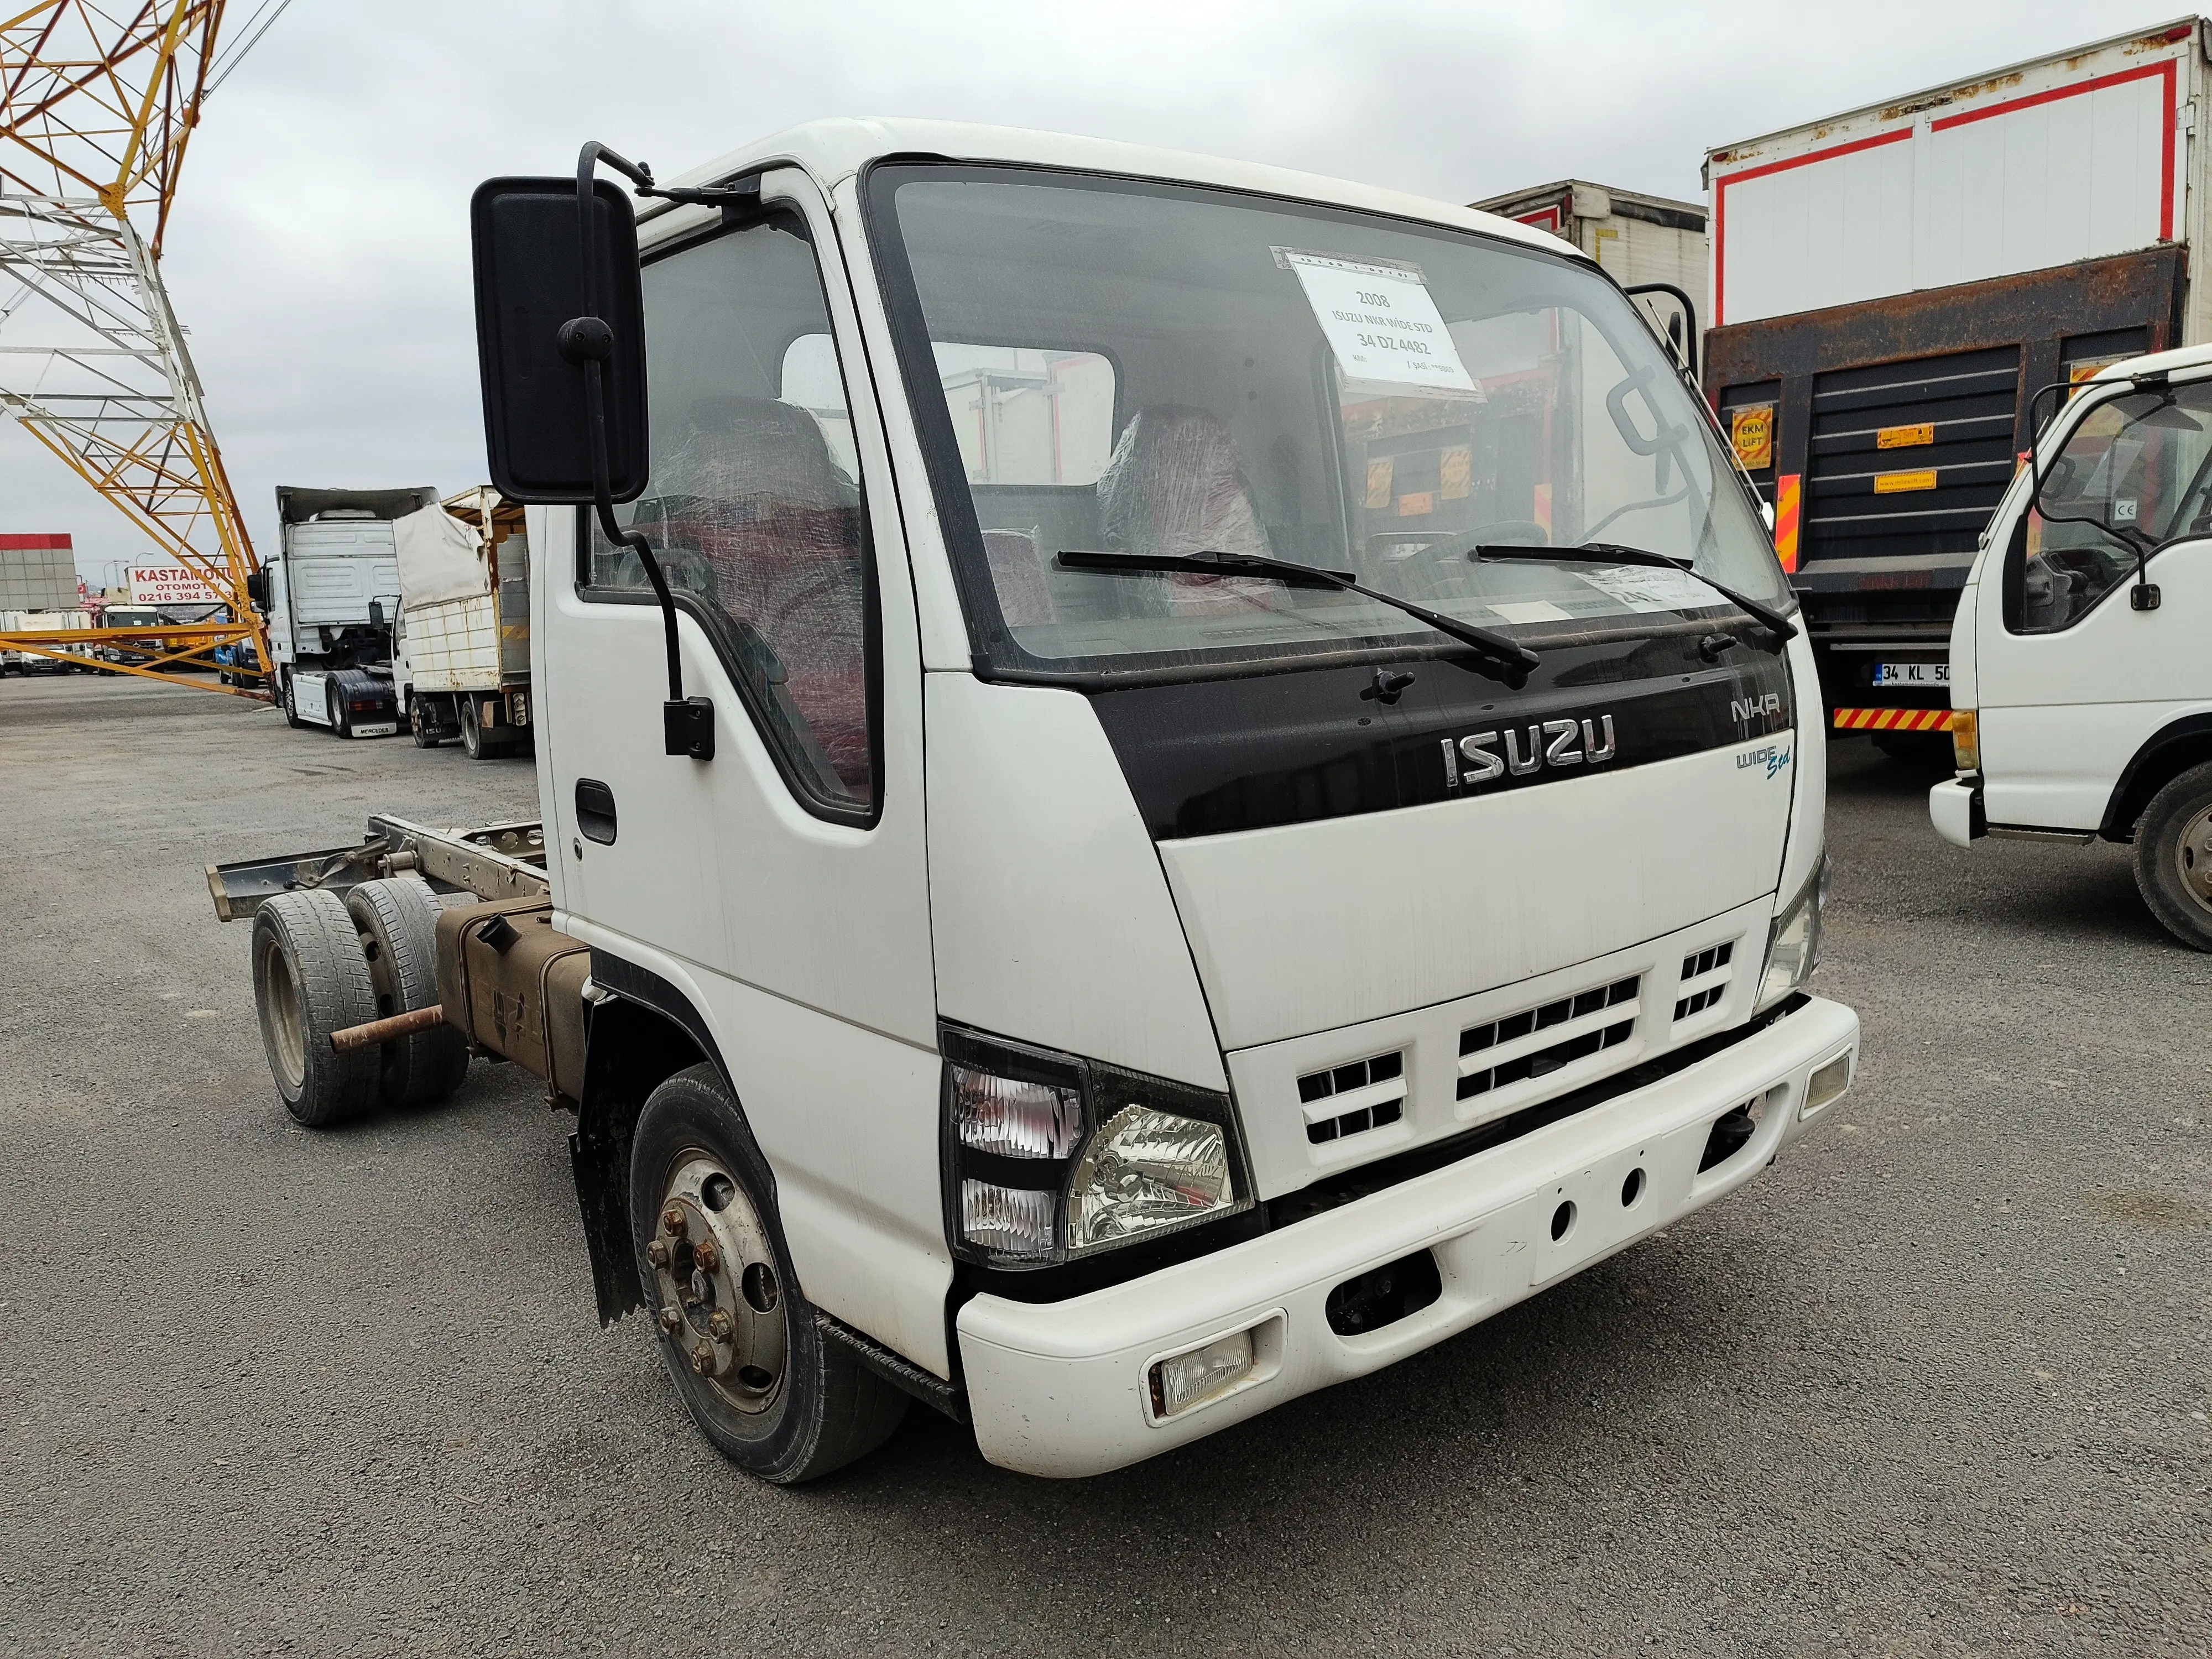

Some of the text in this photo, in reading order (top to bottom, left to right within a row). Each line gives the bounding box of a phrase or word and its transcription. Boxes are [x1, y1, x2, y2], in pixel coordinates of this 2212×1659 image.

[1356, 291, 1390, 307] 2008
[1332, 311, 1363, 323] ISUZU
[1364, 315, 1386, 326] NKR
[1413, 322, 1433, 333] STD
[1357, 333, 1431, 355] 34 DZ 4482
[1742, 424, 1764, 435] EKM
[1743, 436, 1762, 447] LIFT
[2118, 505, 2135, 515] CE
[155, 583, 221, 591] OTOMOTV
[139, 593, 171, 602] 0216
[176, 592, 201, 601] 394
[1883, 665, 1898, 680] 34
[1908, 665, 1924, 680] KL
[1731, 693, 1781, 722] NKR
[1441, 714, 1615, 787] ISUZU
[1736, 745, 1777, 769] WIDE
